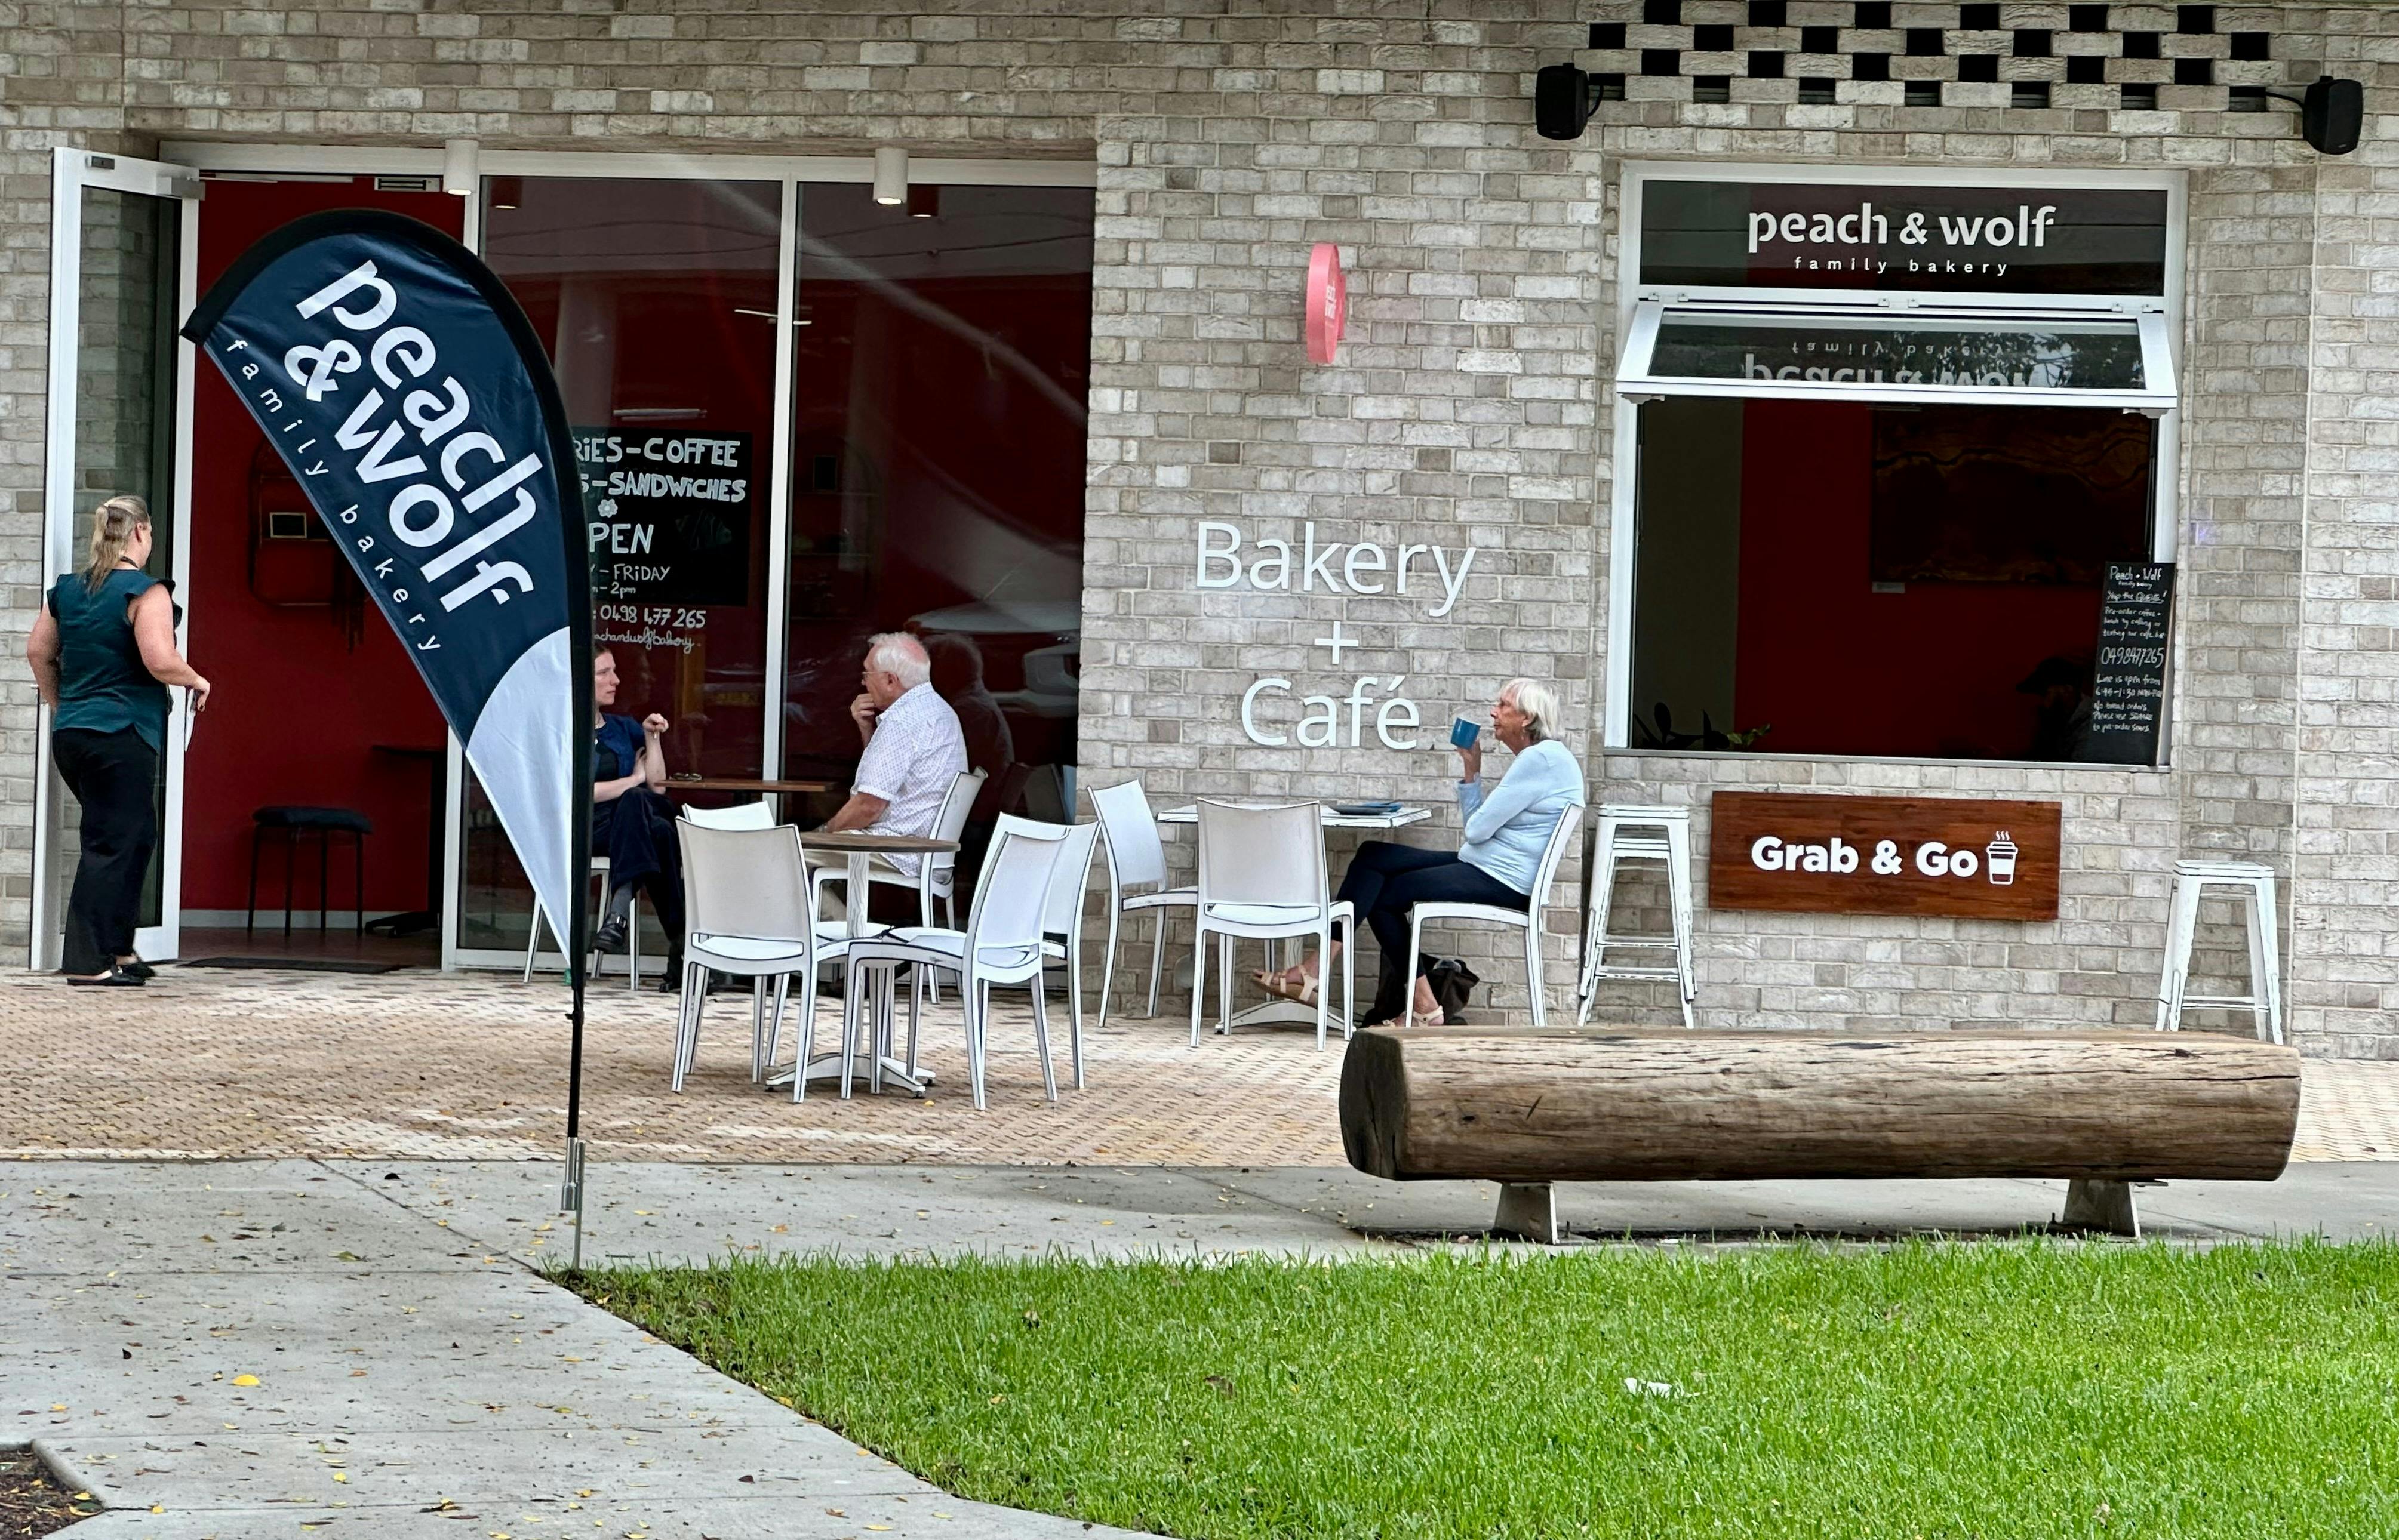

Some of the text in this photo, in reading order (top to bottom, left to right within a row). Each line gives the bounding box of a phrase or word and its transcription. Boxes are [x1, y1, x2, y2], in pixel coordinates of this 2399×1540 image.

[1748, 202, 2056, 254] peach & wolf
[1794, 256, 2007, 276] family bakery
[296, 260, 543, 546] peach
[227, 339, 443, 652] family bakery
[284, 339, 534, 612] & wolf
[588, 522, 654, 554] PEN
[1196, 522, 1477, 617] Bakery
[2109, 565, 2133, 581] Peach
[2143, 567, 2163, 581] Wolf
[600, 604, 707, 629] 0498 477 265
[1241, 675, 1420, 750] Café
[1751, 836, 1979, 877] Grab & Go
